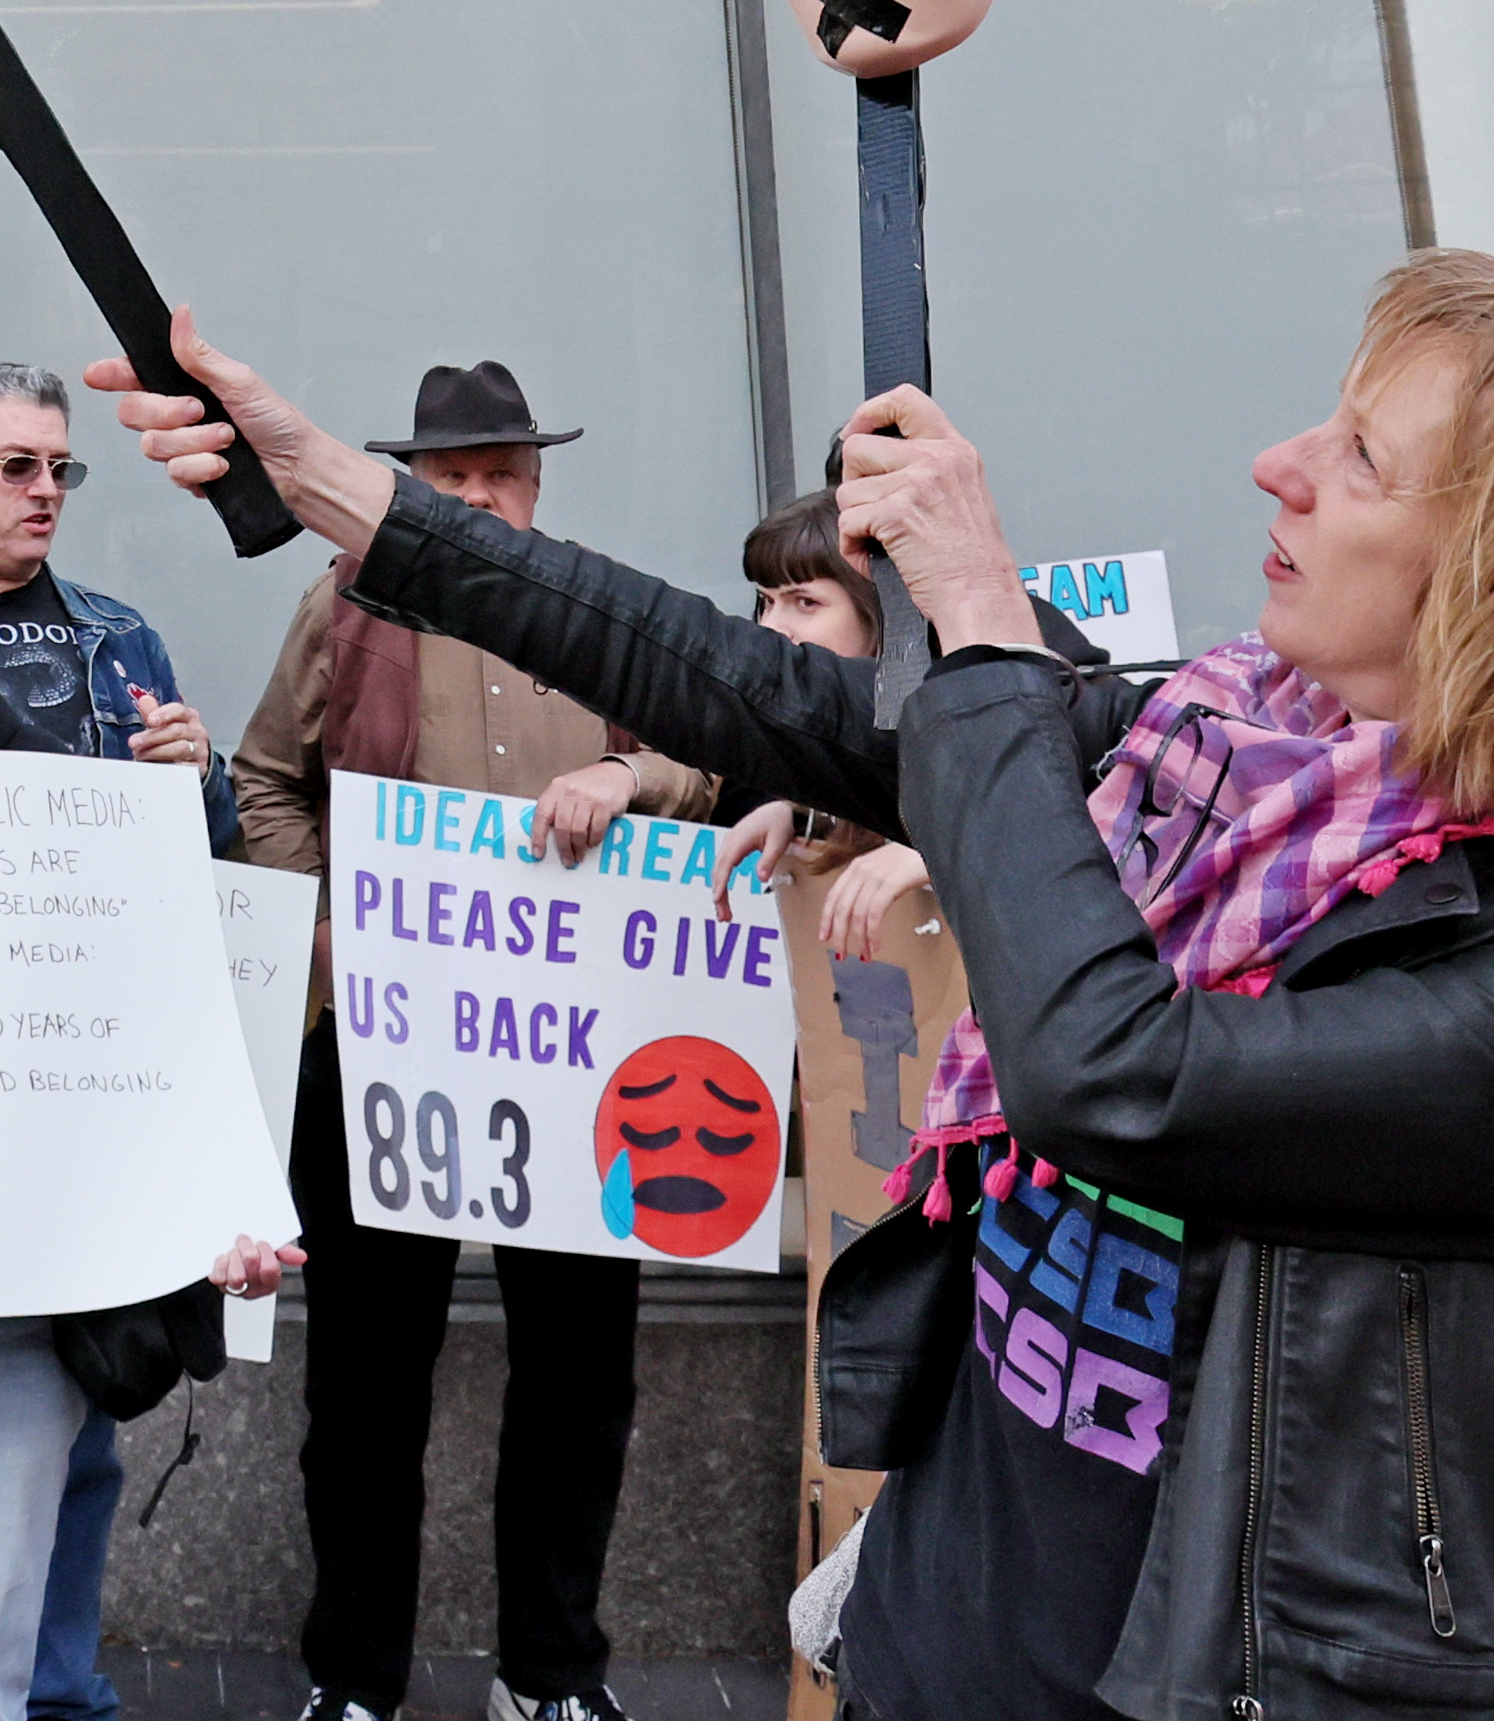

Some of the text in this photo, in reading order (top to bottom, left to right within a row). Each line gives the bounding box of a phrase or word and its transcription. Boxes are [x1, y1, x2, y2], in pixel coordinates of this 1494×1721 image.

[46, 787, 146, 828] MEDIA:
[31, 848, 80, 875] ARE
[354, 869, 780, 988] PLEASE GIVE
[9, 940, 96, 968] MEDIA:
[10, 1012, 81, 1039] YEARS
[91, 1017, 121, 1039] OF
[346, 971, 601, 1070] US BACK
[29, 1069, 172, 1094] BELONGING
[362, 1080, 532, 1230] 89.3
